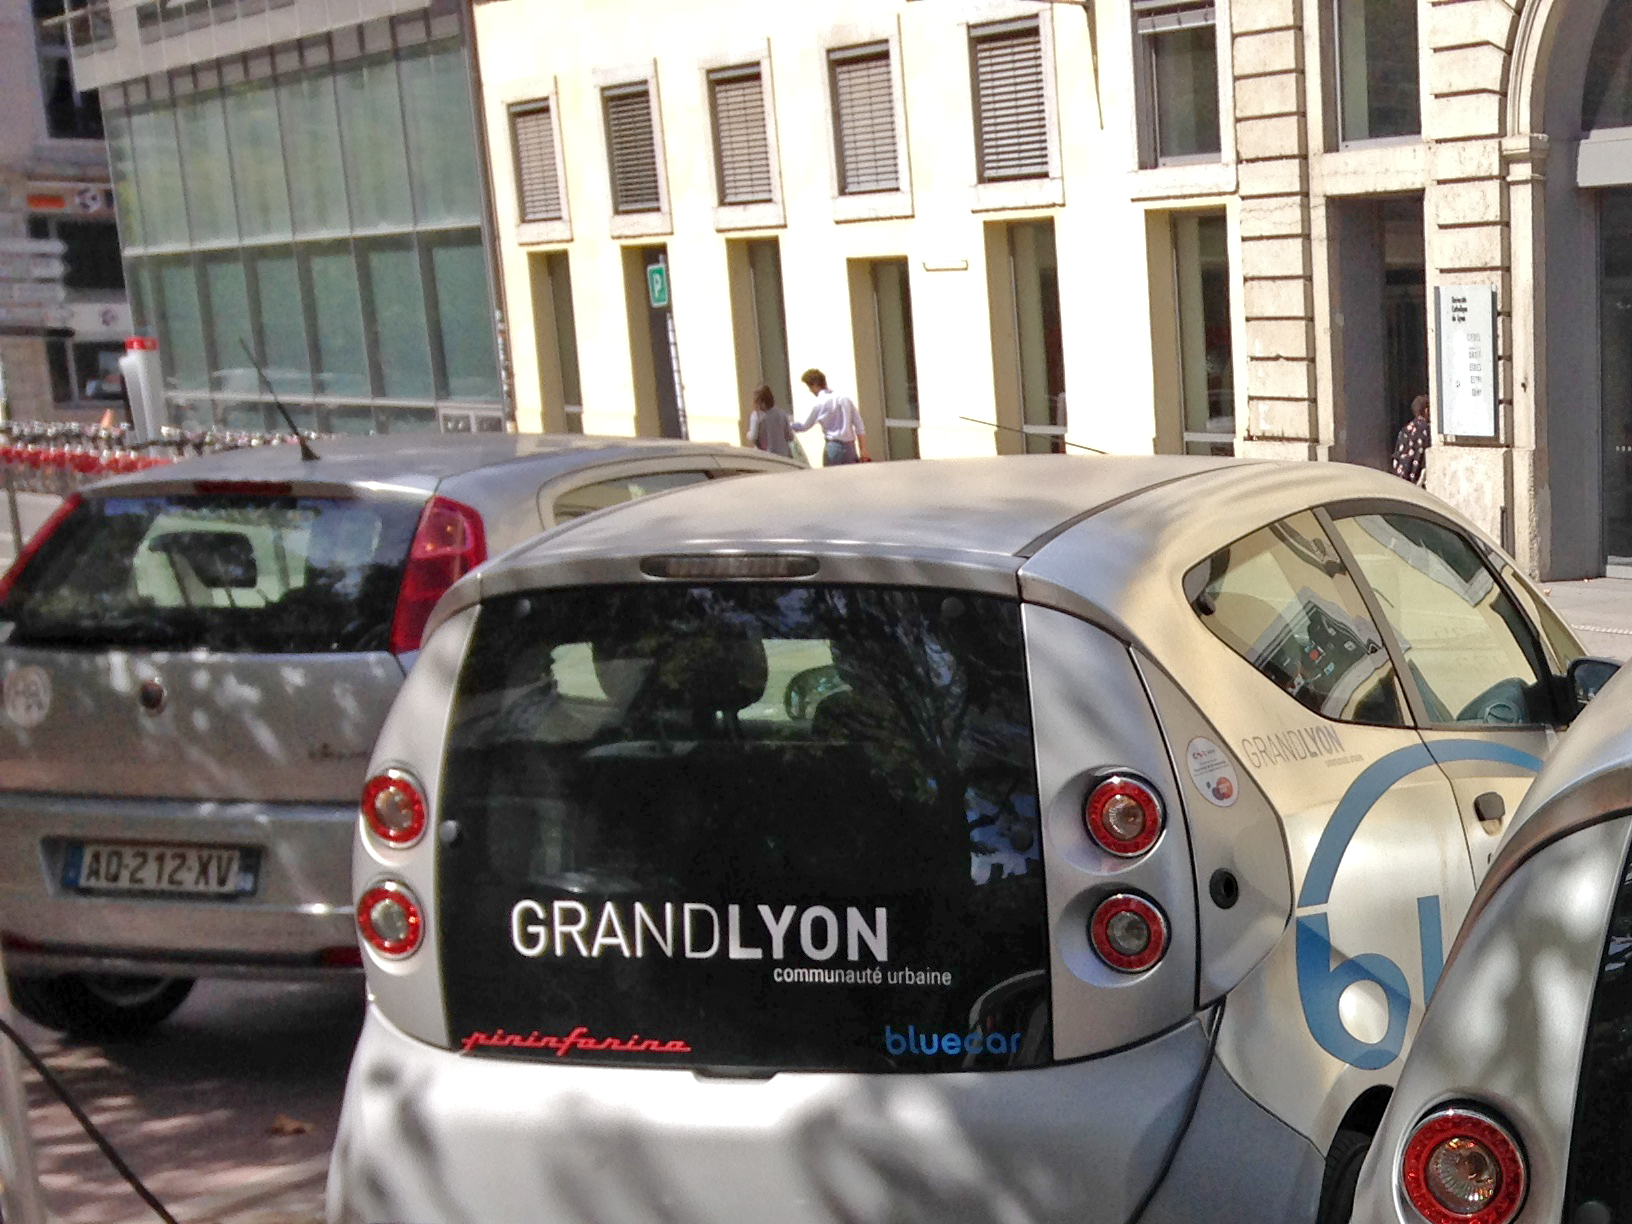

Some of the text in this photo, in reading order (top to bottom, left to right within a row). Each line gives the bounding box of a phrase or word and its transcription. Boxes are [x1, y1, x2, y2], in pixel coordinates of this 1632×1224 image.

[1242, 723, 1345, 769] GRANDLYON
[511, 899, 888, 962] GRANDLYON
[773, 964, 952, 987] communauté urbaine
[461, 1026, 692, 1056] pininfarina
[885, 1025, 1022, 1056] bluecar
